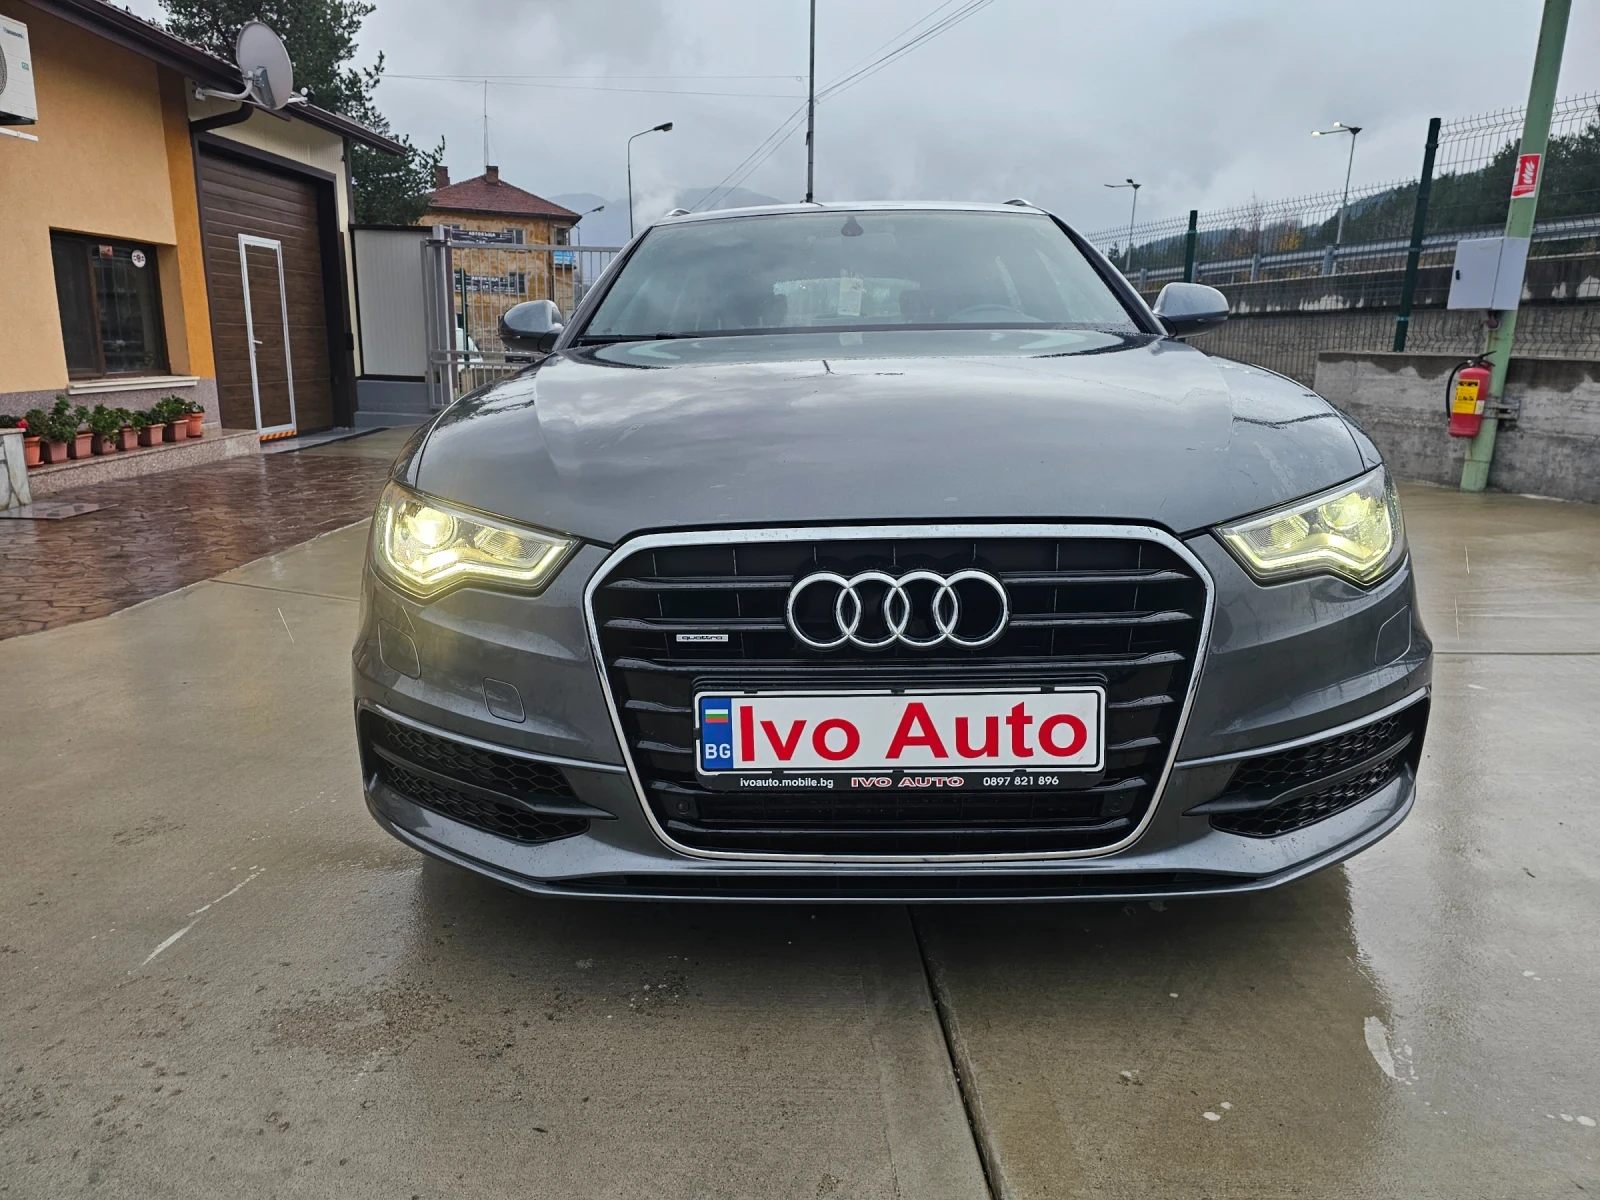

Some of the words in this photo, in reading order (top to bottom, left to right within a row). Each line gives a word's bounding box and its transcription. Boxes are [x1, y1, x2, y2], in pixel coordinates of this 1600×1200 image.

[740, 706, 860, 761] Ivo
[885, 701, 1088, 759] Auto
[705, 743, 731, 759] BG
[740, 777, 834, 788] ivoauto.mobile.bg
[851, 777, 892, 787] IVO
[898, 777, 964, 787] AUTO
[983, 776, 1010, 786] 0897
[1014, 776, 1033, 785] 821
[1038, 776, 1059, 785] 896
